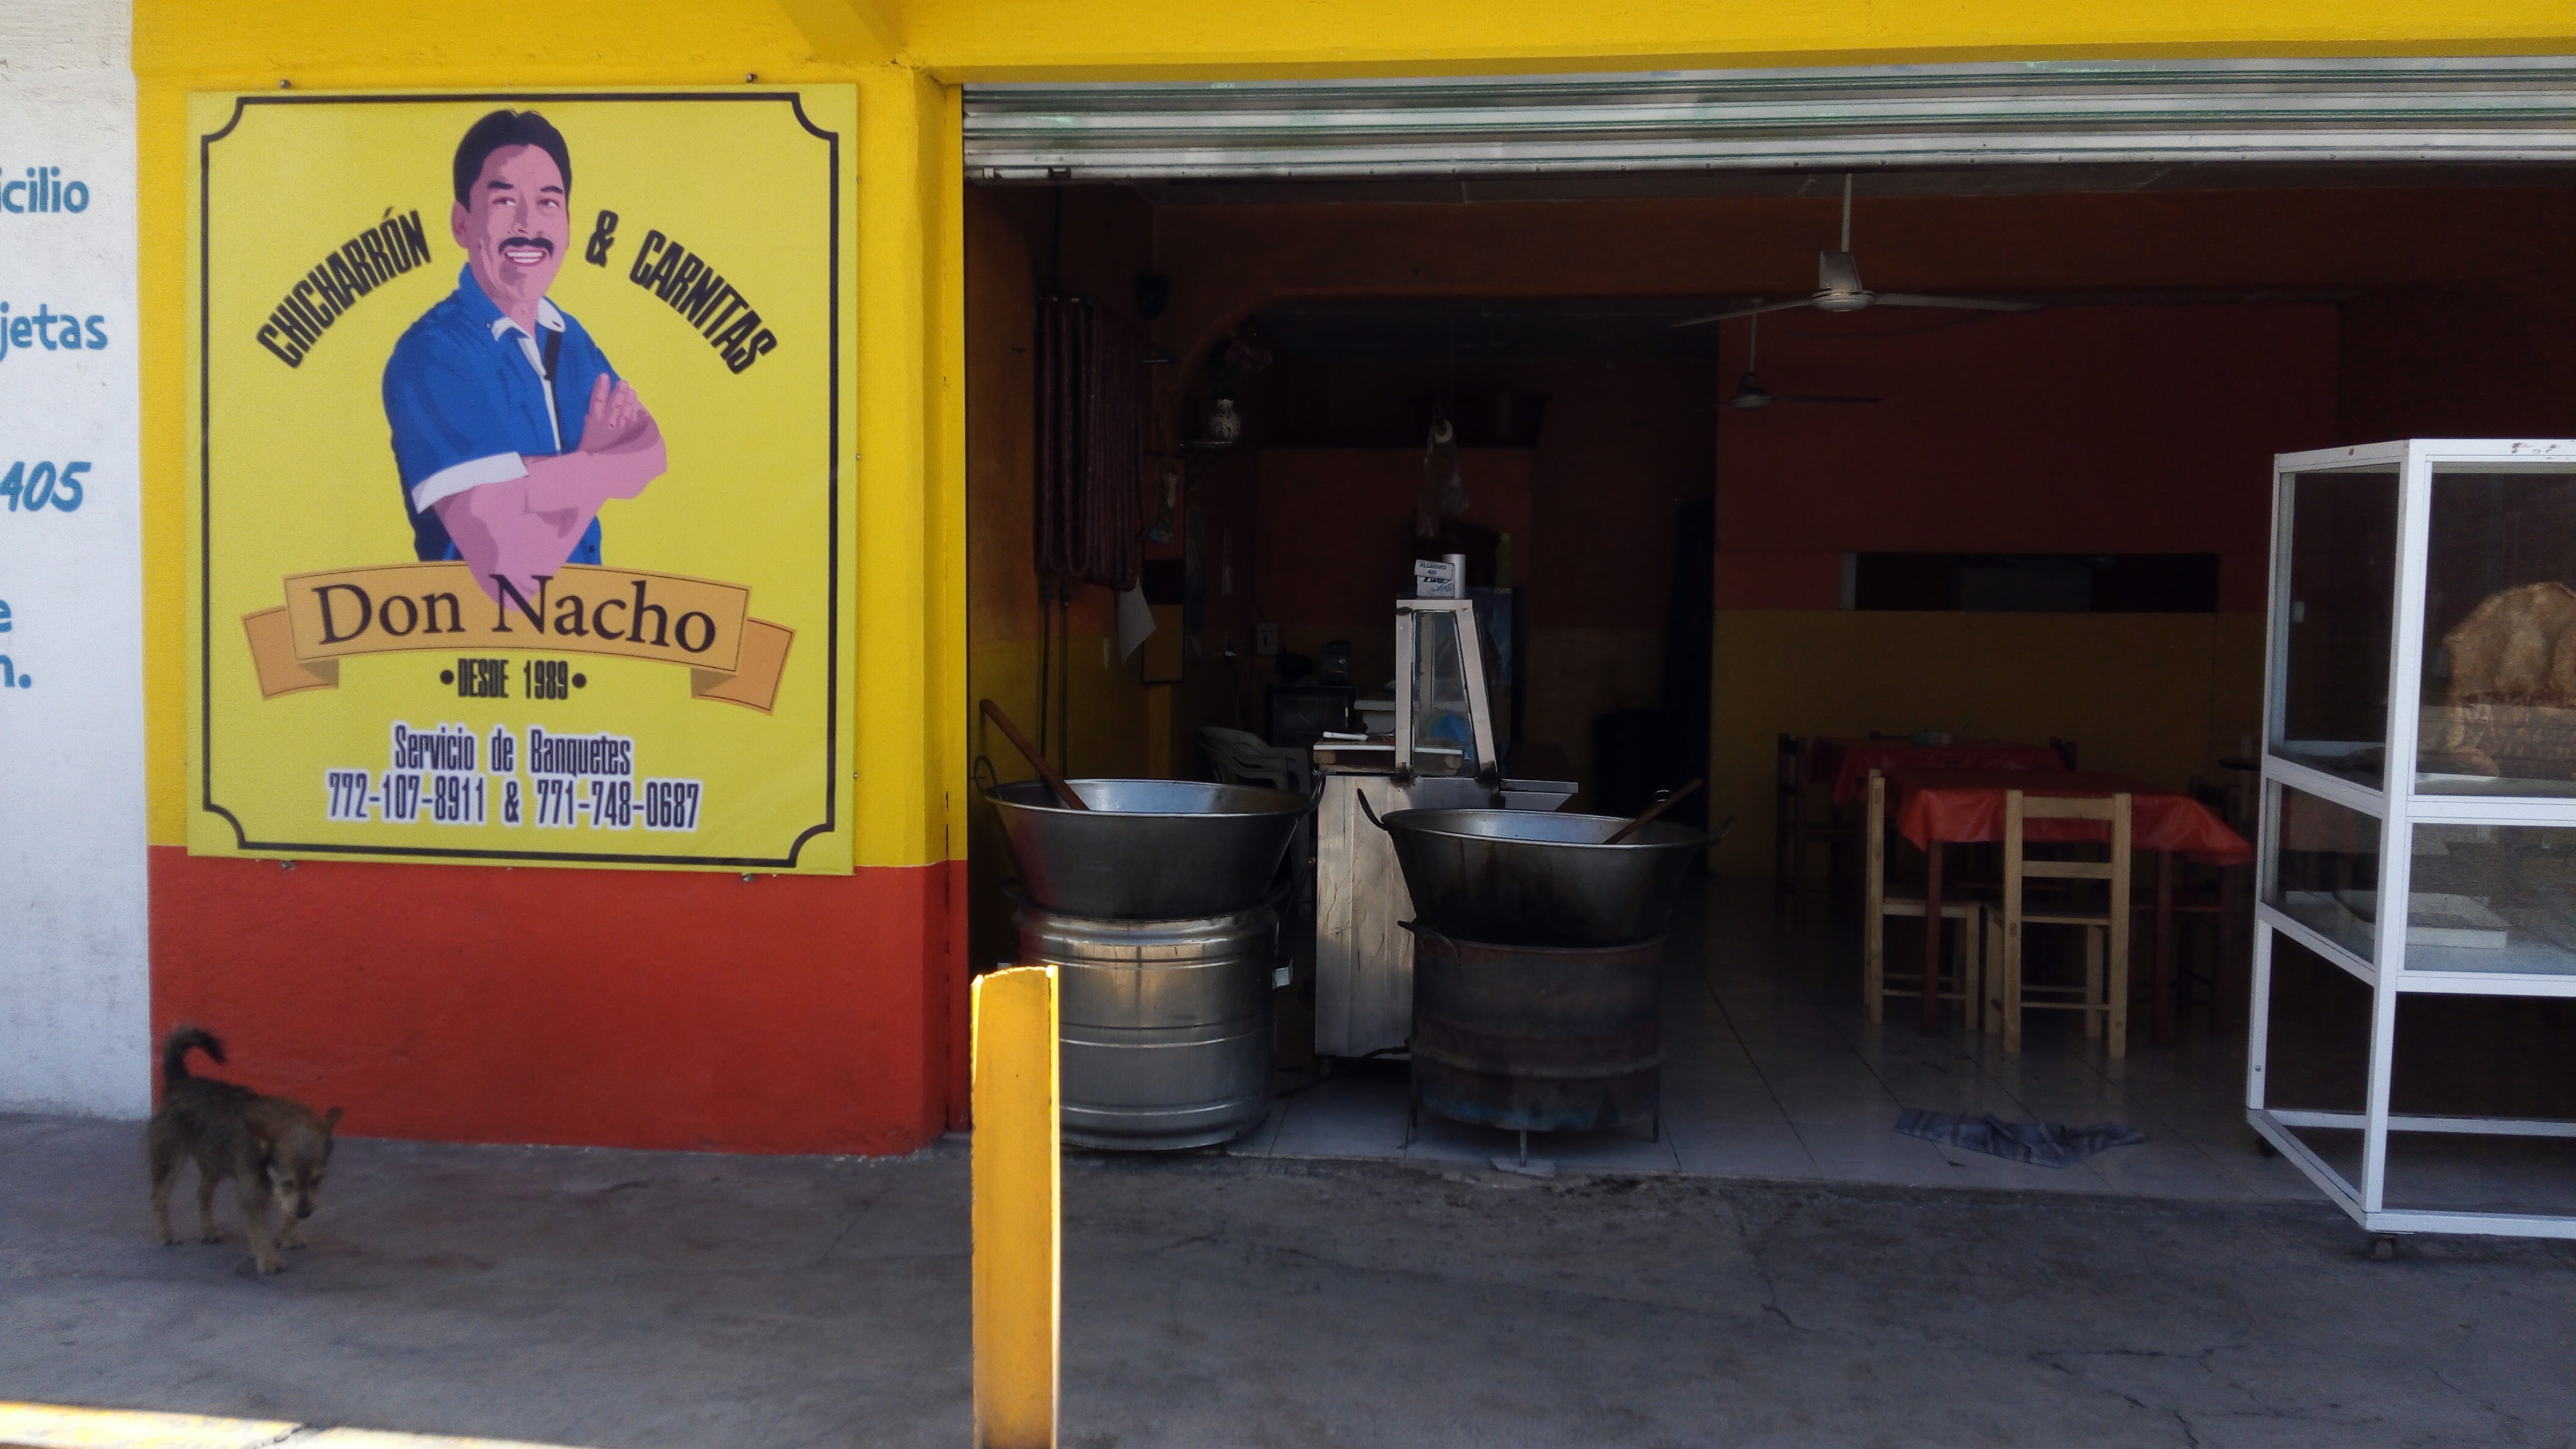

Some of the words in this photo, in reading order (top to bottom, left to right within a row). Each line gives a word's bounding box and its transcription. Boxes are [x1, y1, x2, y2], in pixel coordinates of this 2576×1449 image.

[0, 166, 90, 214] cilio
[257, 206, 431, 368] CHICHARRÓN
[586, 209, 619, 268] &
[630, 230, 778, 375] CARNITAS
[311, 583, 466, 645] Don
[490, 574, 716, 654] Nacho
[456, 658, 509, 699] DESDE
[524, 659, 569, 700] 1989
[394, 724, 474, 771] Servicio
[491, 728, 514, 772] de
[530, 729, 631, 778] Banquetes
[329, 772, 484, 823] 772-107-8911
[504, 781, 519, 823] &
[537, 779, 700, 829] 771-748-0687
